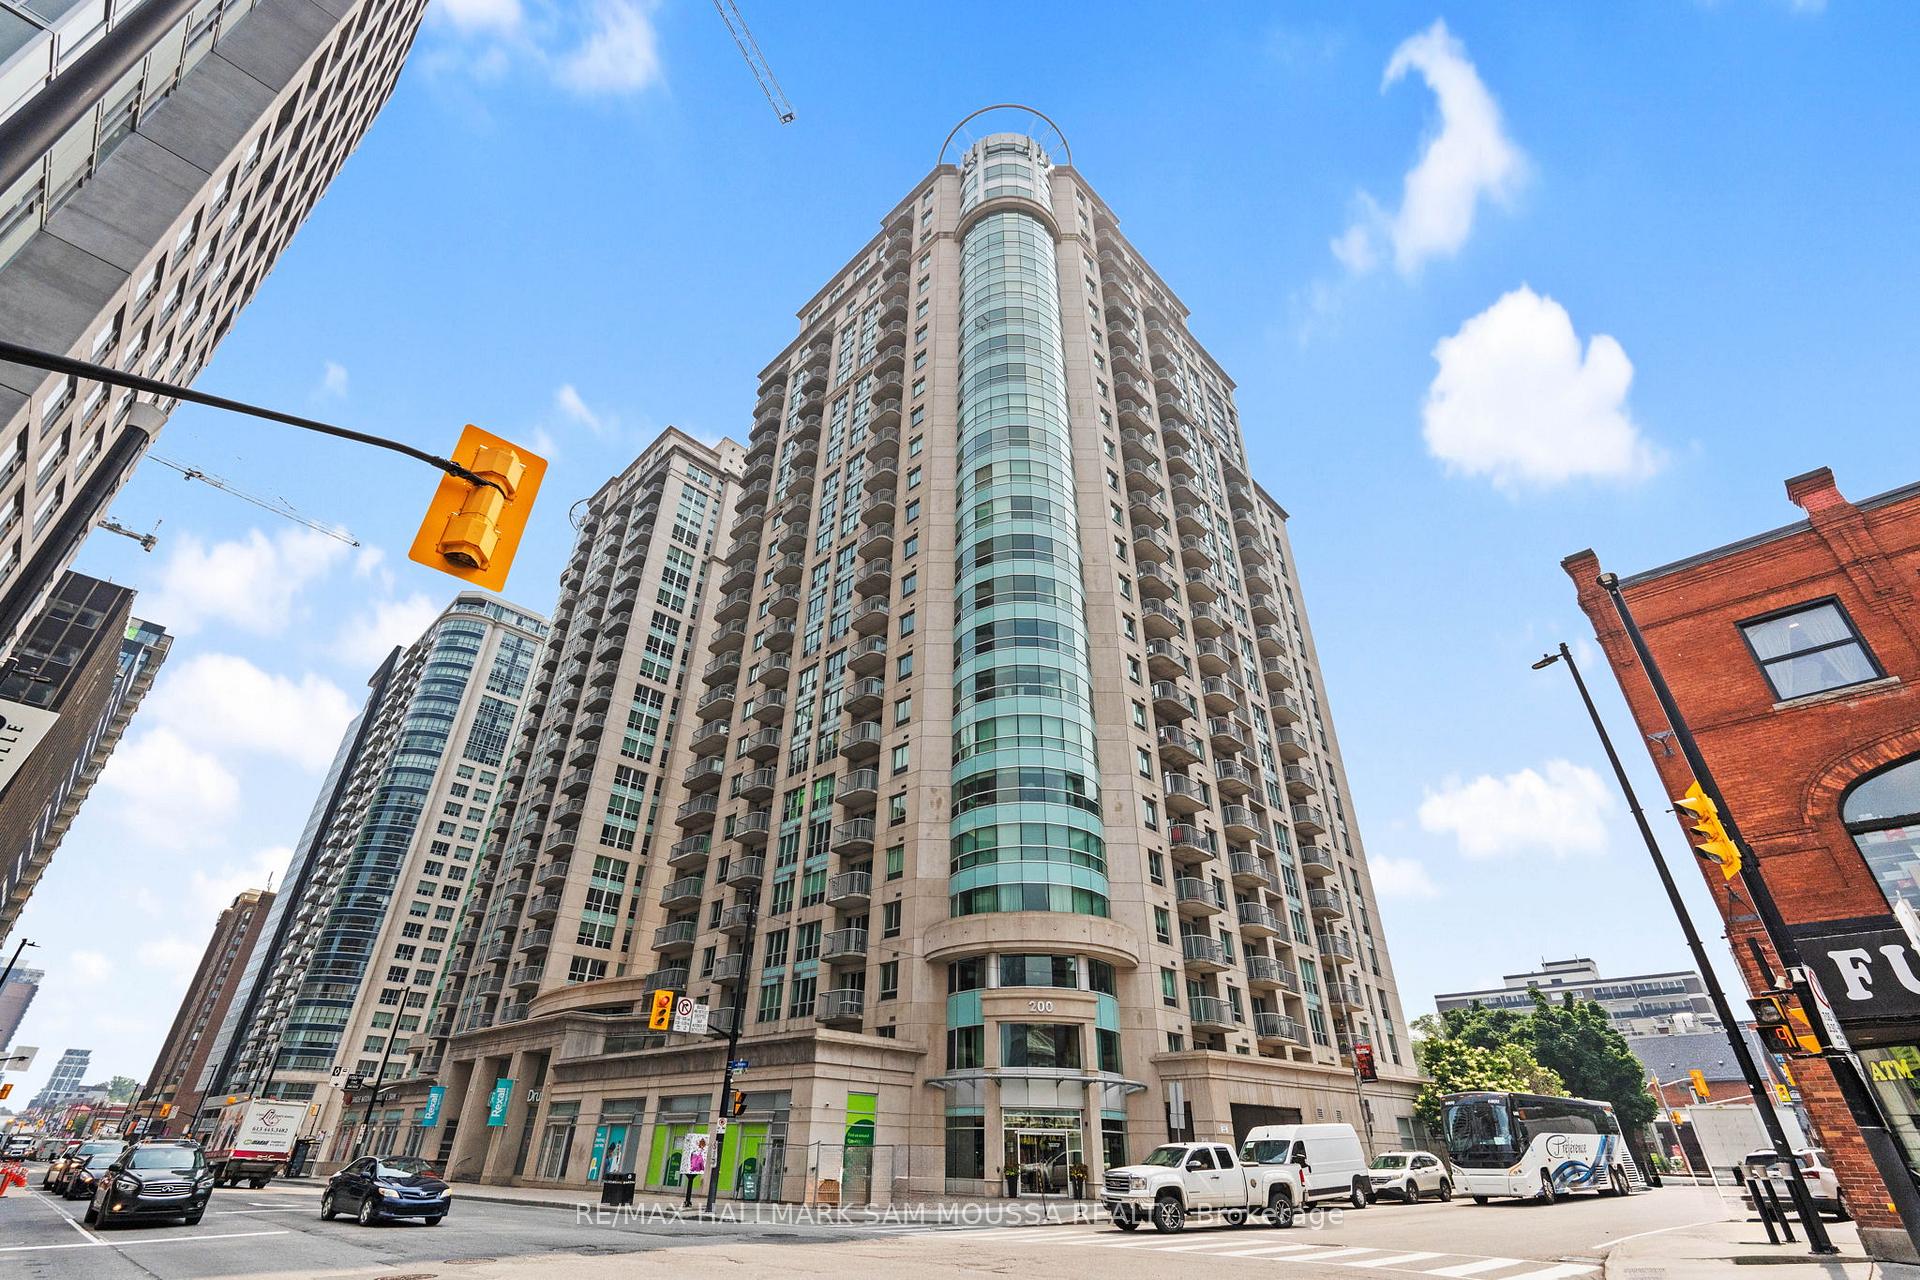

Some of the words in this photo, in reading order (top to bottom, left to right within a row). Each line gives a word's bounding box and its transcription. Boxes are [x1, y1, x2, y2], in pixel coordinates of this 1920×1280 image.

[0, 724, 24, 762] LLE
[1028, 1000, 1054, 1012] 200
[1870, 1059, 1915, 1082] ATM
[424, 1093, 439, 1119] Rexall
[491, 1088, 506, 1118] Rexall
